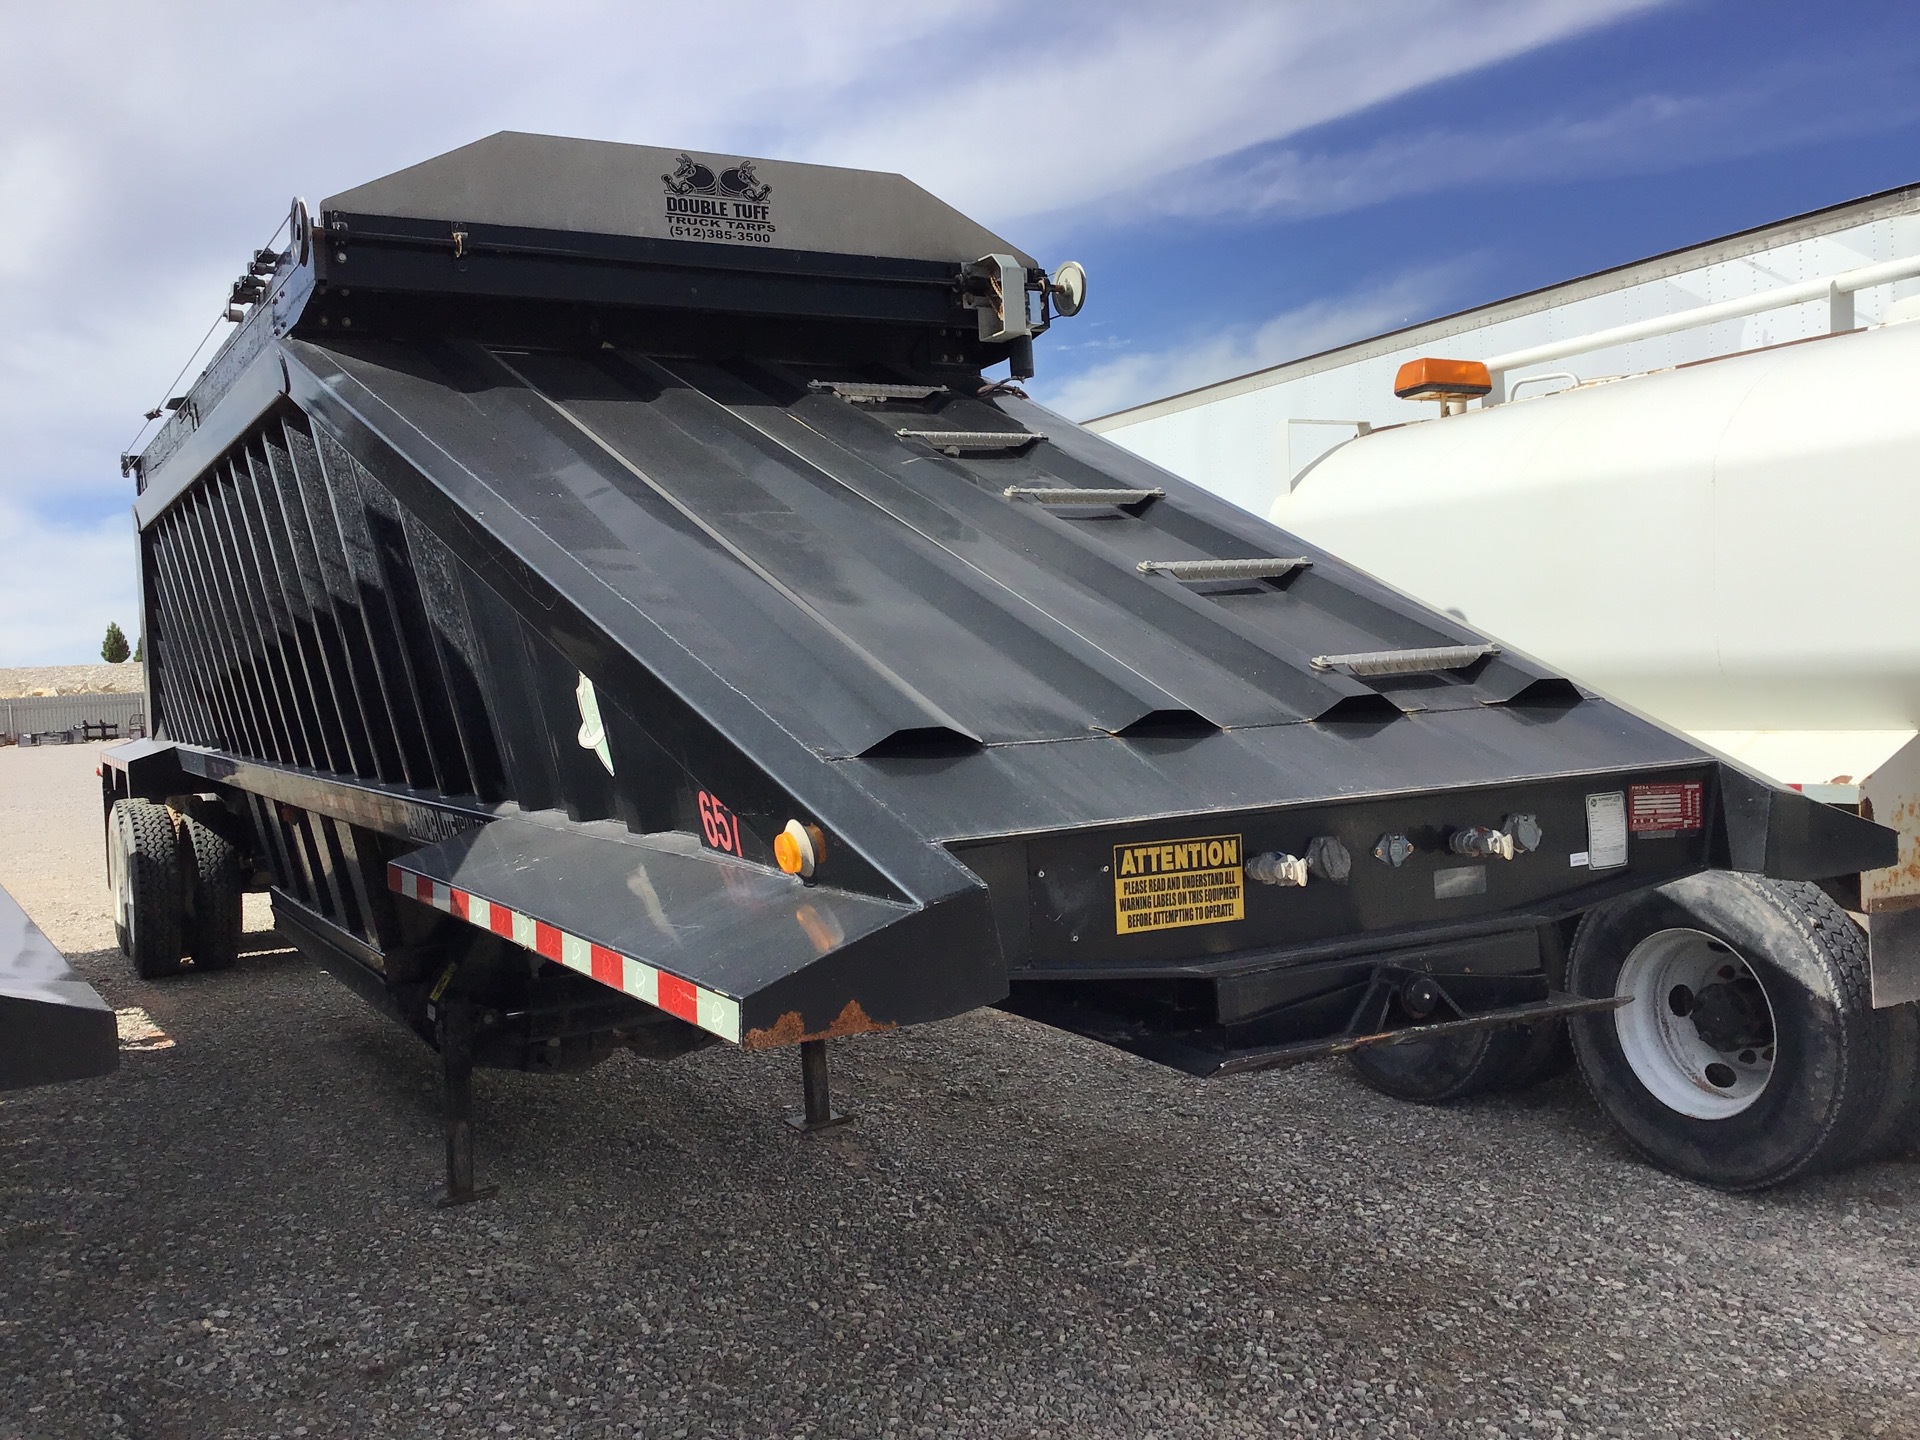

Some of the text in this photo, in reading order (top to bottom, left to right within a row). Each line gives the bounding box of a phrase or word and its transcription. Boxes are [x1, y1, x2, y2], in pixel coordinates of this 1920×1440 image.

[666, 196, 770, 220] DOUBLE TUFF
[664, 215, 776, 233] TRUCK TARPS
[669, 225, 771, 243] (512)385-3500
[1120, 839, 1238, 876] ATTENTION
[1123, 870, 1236, 896] PLEASE READ AND UNDERSTAND ALL
[1119, 885, 1241, 912] WARNING LABELS ON THIS EQUIPMENT
[1127, 903, 1234, 929] BEFORE ATTEMPTING TO OPERATE!
